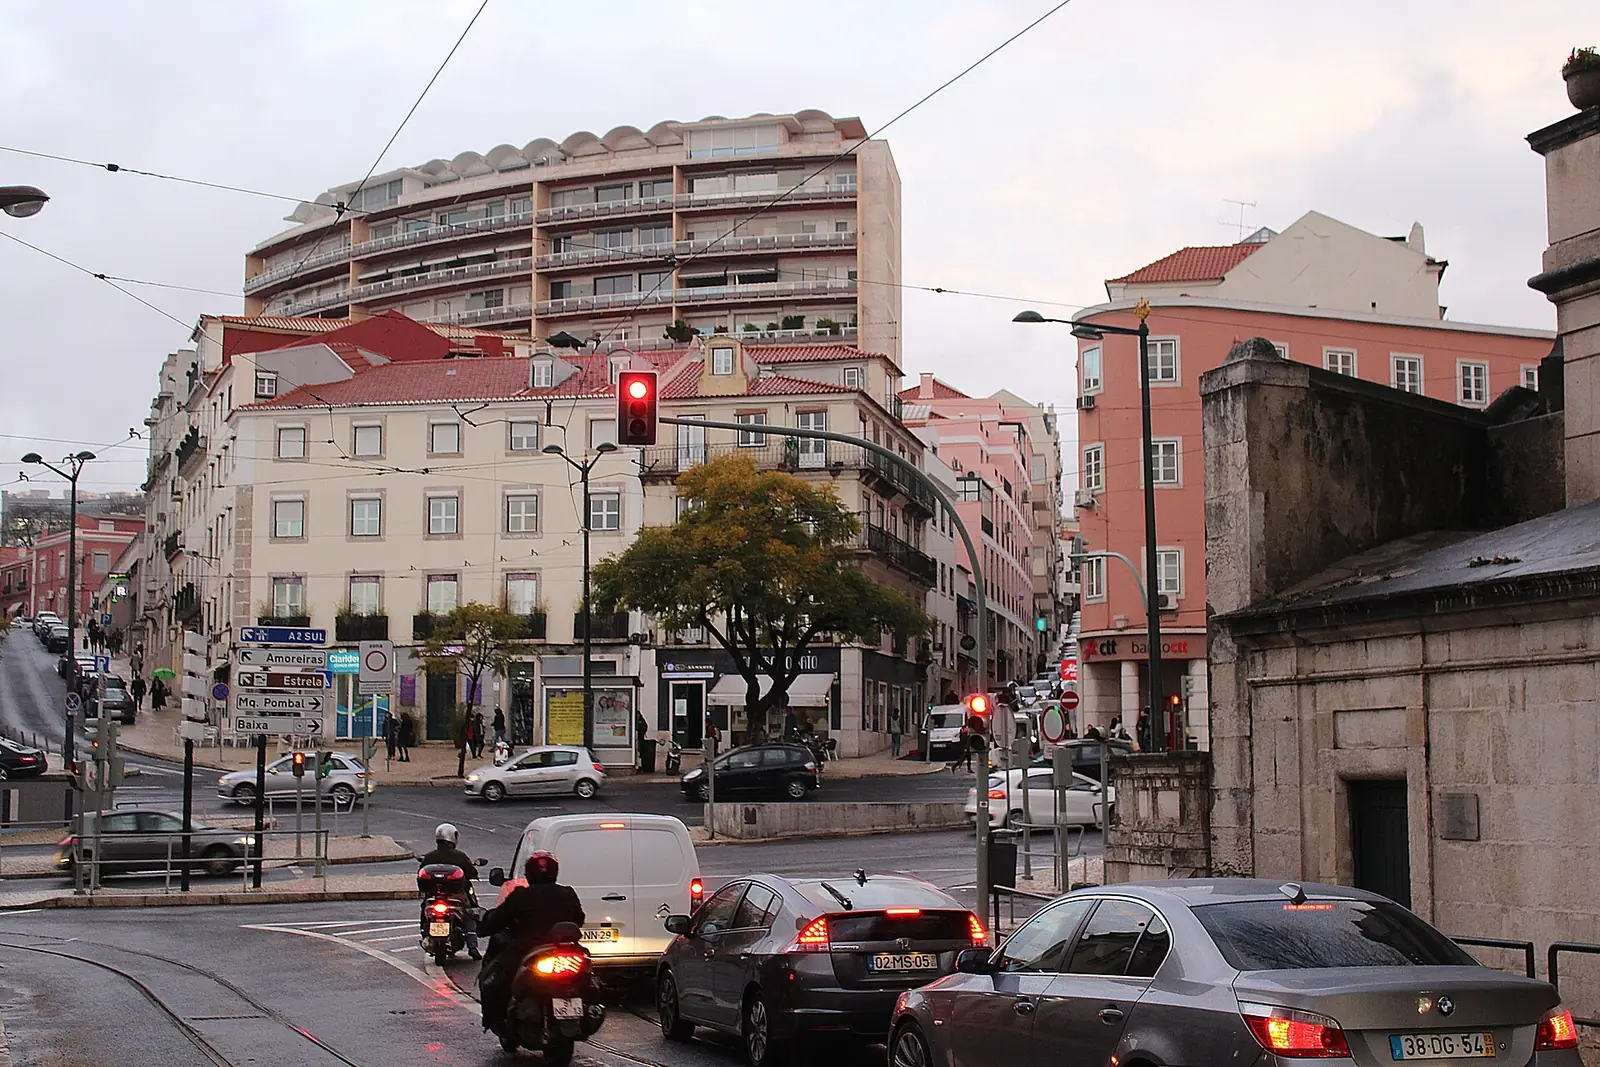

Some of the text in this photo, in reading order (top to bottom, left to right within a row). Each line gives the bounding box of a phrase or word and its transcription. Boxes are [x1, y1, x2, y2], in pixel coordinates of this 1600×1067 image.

[288, 632, 325, 642] A2 SUL
[1099, 639, 1117, 656] ctt
[266, 653, 324, 665] Amoreiras
[283, 675, 322, 687] Estrela
[238, 697, 305, 709] Mq. Pombal
[237, 719, 269, 730] Baixa
